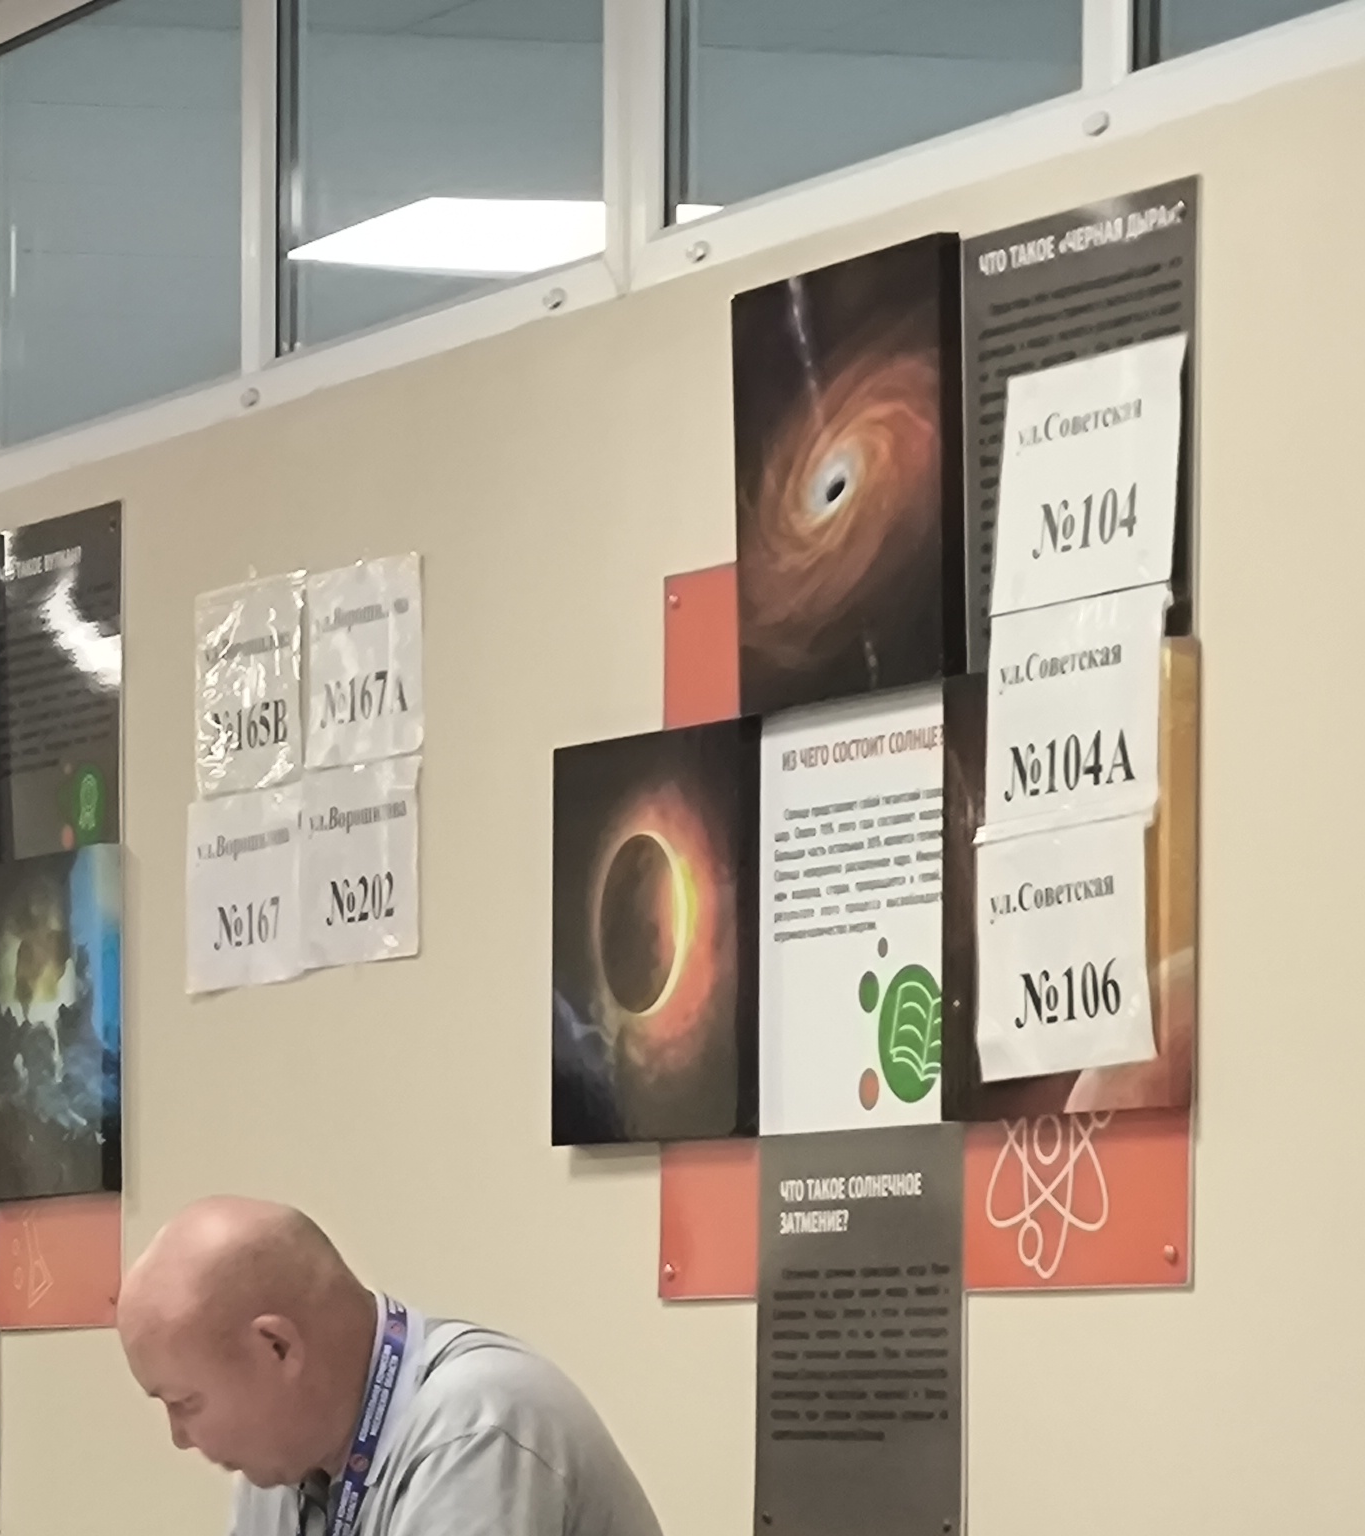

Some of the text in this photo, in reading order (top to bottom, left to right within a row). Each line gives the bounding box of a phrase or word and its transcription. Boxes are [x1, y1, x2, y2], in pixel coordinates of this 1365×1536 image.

[979, 249, 1007, 276] ЧТО
[1010, 235, 1055, 269] ТАКОЕ
[1032, 482, 1137, 560] №104
[782, 750, 797, 771] ИЗ
[800, 745, 829, 768] ЧЕГО
[833, 735, 885, 764] СОСТОИТ
[326, 871, 395, 926] №202
[214, 896, 280, 951] №167
[1015, 957, 1122, 1030] №106
[780, 1172, 922, 1201] ЧТО ТАКОЕ СОЛНЕЧНОЕ
[779, 1208, 849, 1234] ЗАТМЕНИЕ?
